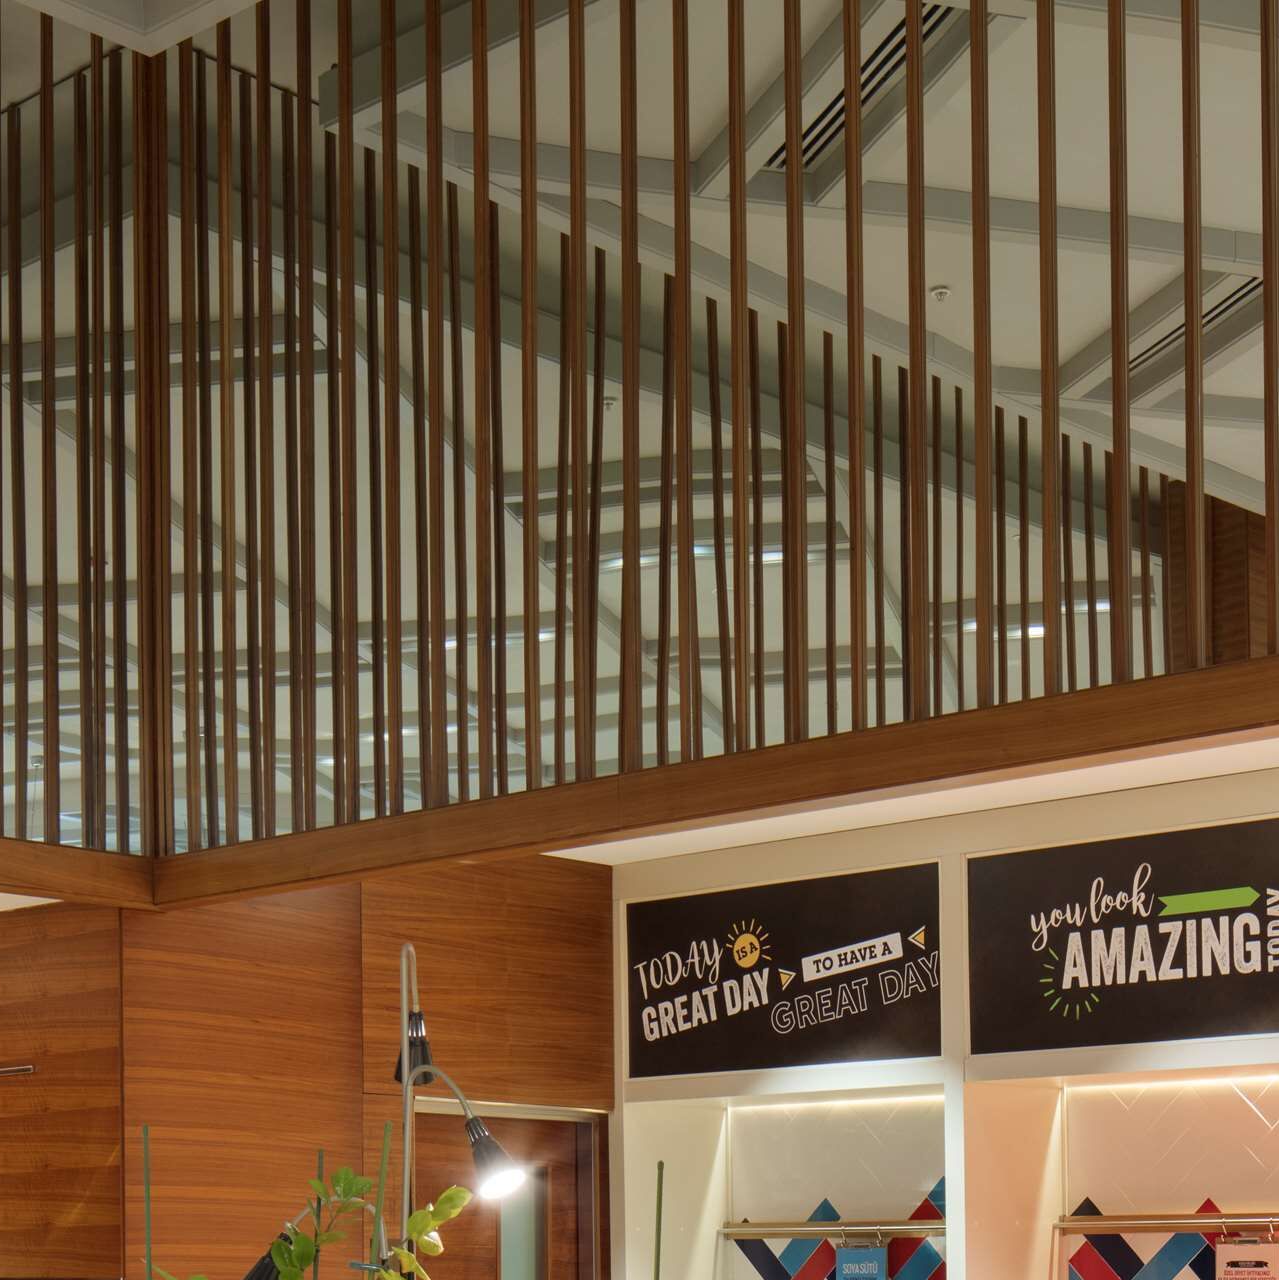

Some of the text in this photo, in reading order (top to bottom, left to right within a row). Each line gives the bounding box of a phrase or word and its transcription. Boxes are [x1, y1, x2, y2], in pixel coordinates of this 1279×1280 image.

[1030, 862, 1155, 951] you look
[633, 937, 724, 1000] TODAY
[736, 942, 759, 960] IS A
[813, 941, 894, 974] TO HAVE A
[1062, 912, 1262, 990] AMAZING
[641, 967, 770, 1042] GREAT DAY
[770, 950, 939, 1034] GREAT DAY
